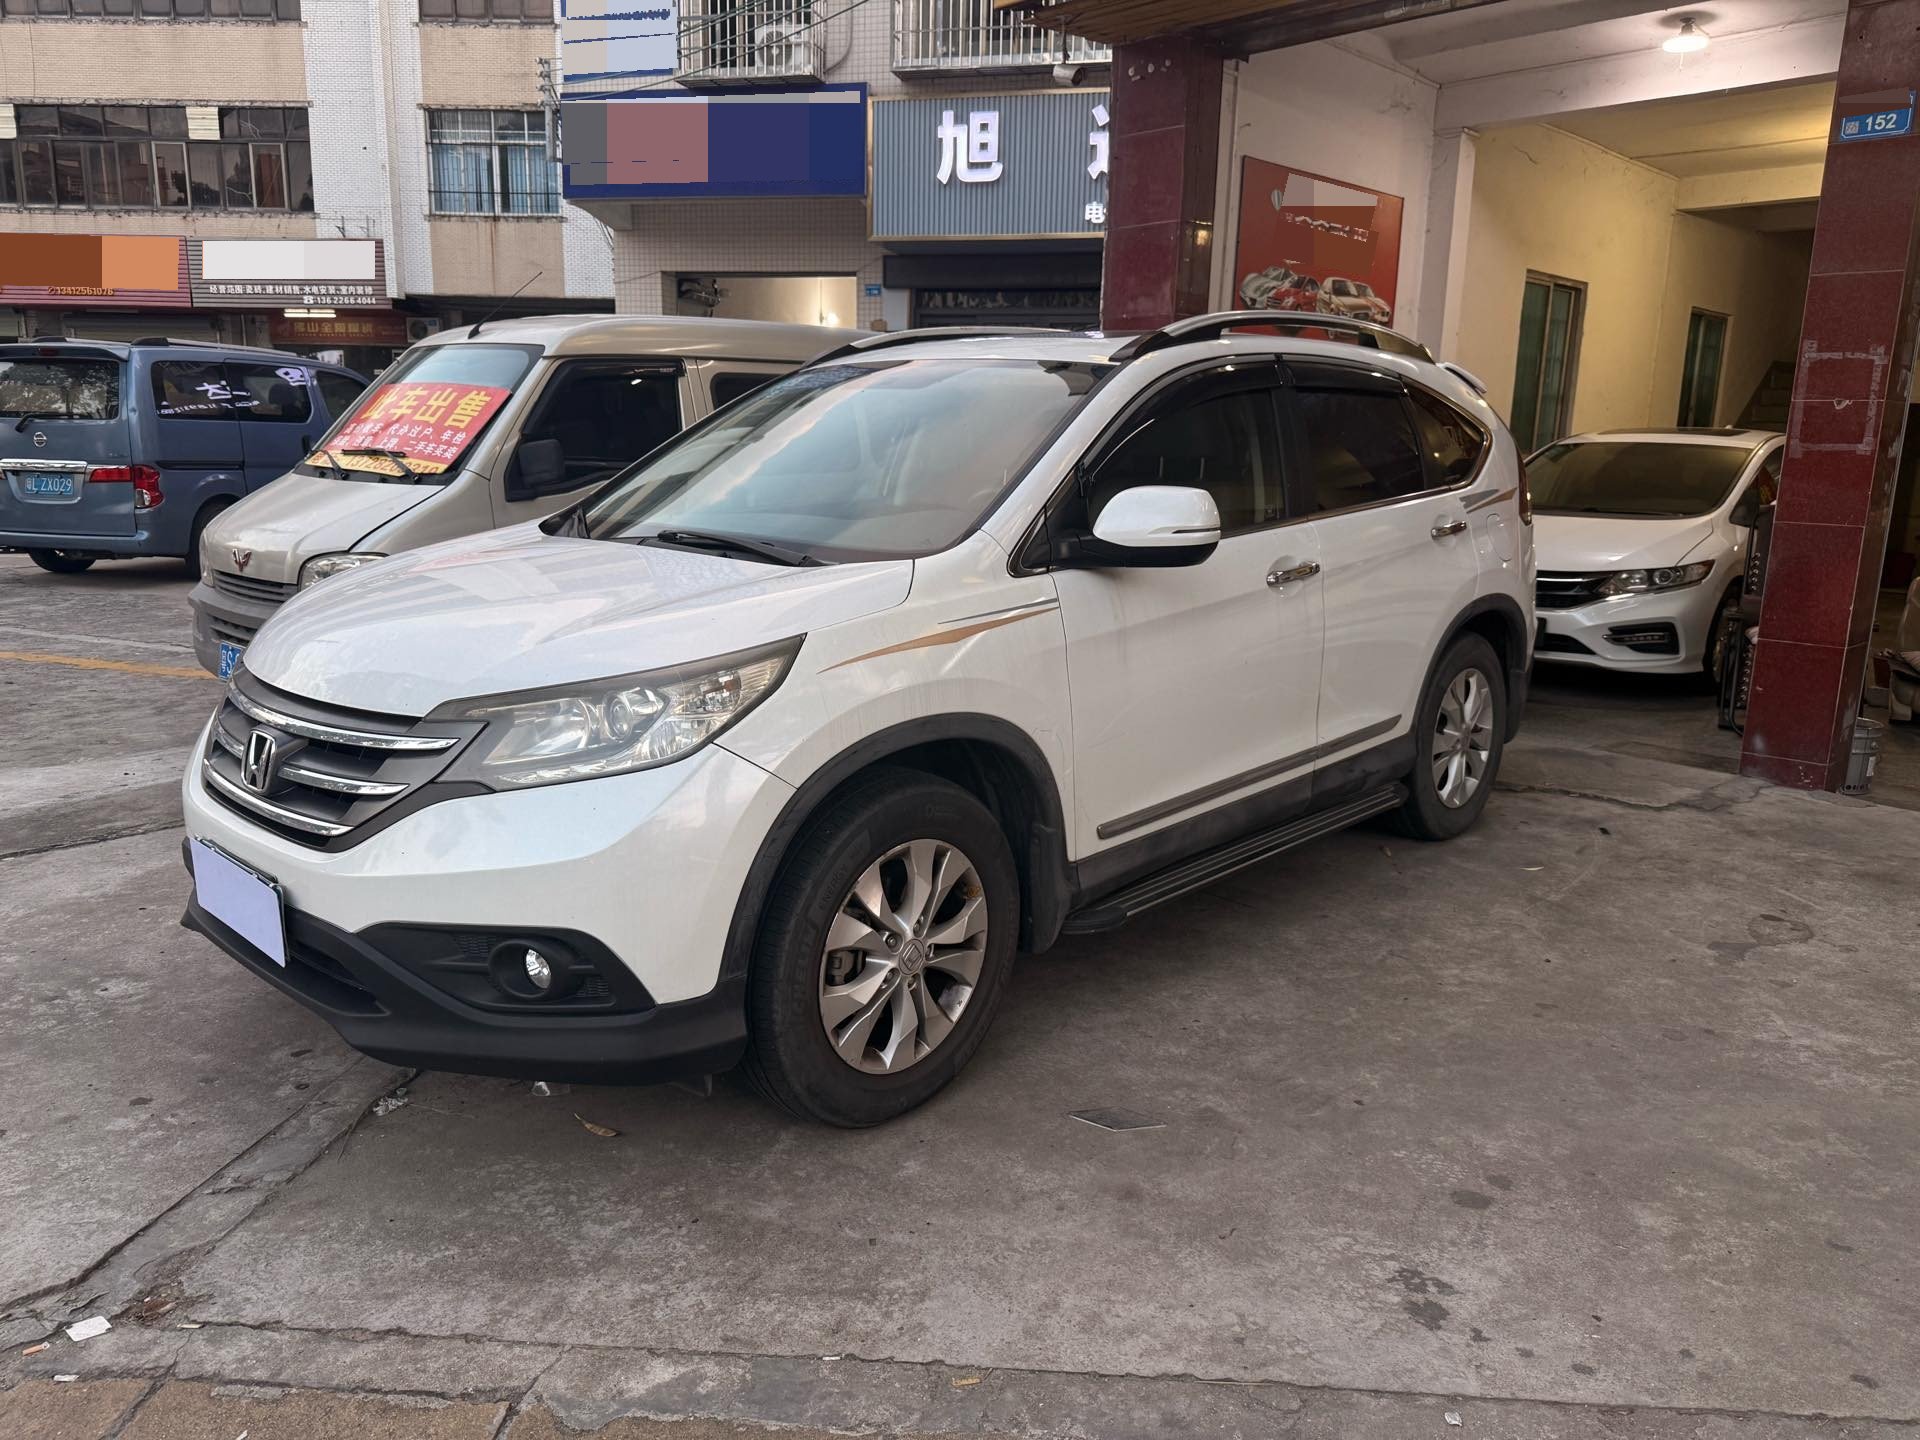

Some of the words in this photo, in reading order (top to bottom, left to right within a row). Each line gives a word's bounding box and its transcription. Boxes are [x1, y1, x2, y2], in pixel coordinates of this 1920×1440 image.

[1865, 113, 1897, 132] 152
[317, 296, 332, 305] 136
[356, 296, 377, 305] 4044
[361, 386, 492, 430] 此车出售
[41, 477, 72, 492] ZX029
